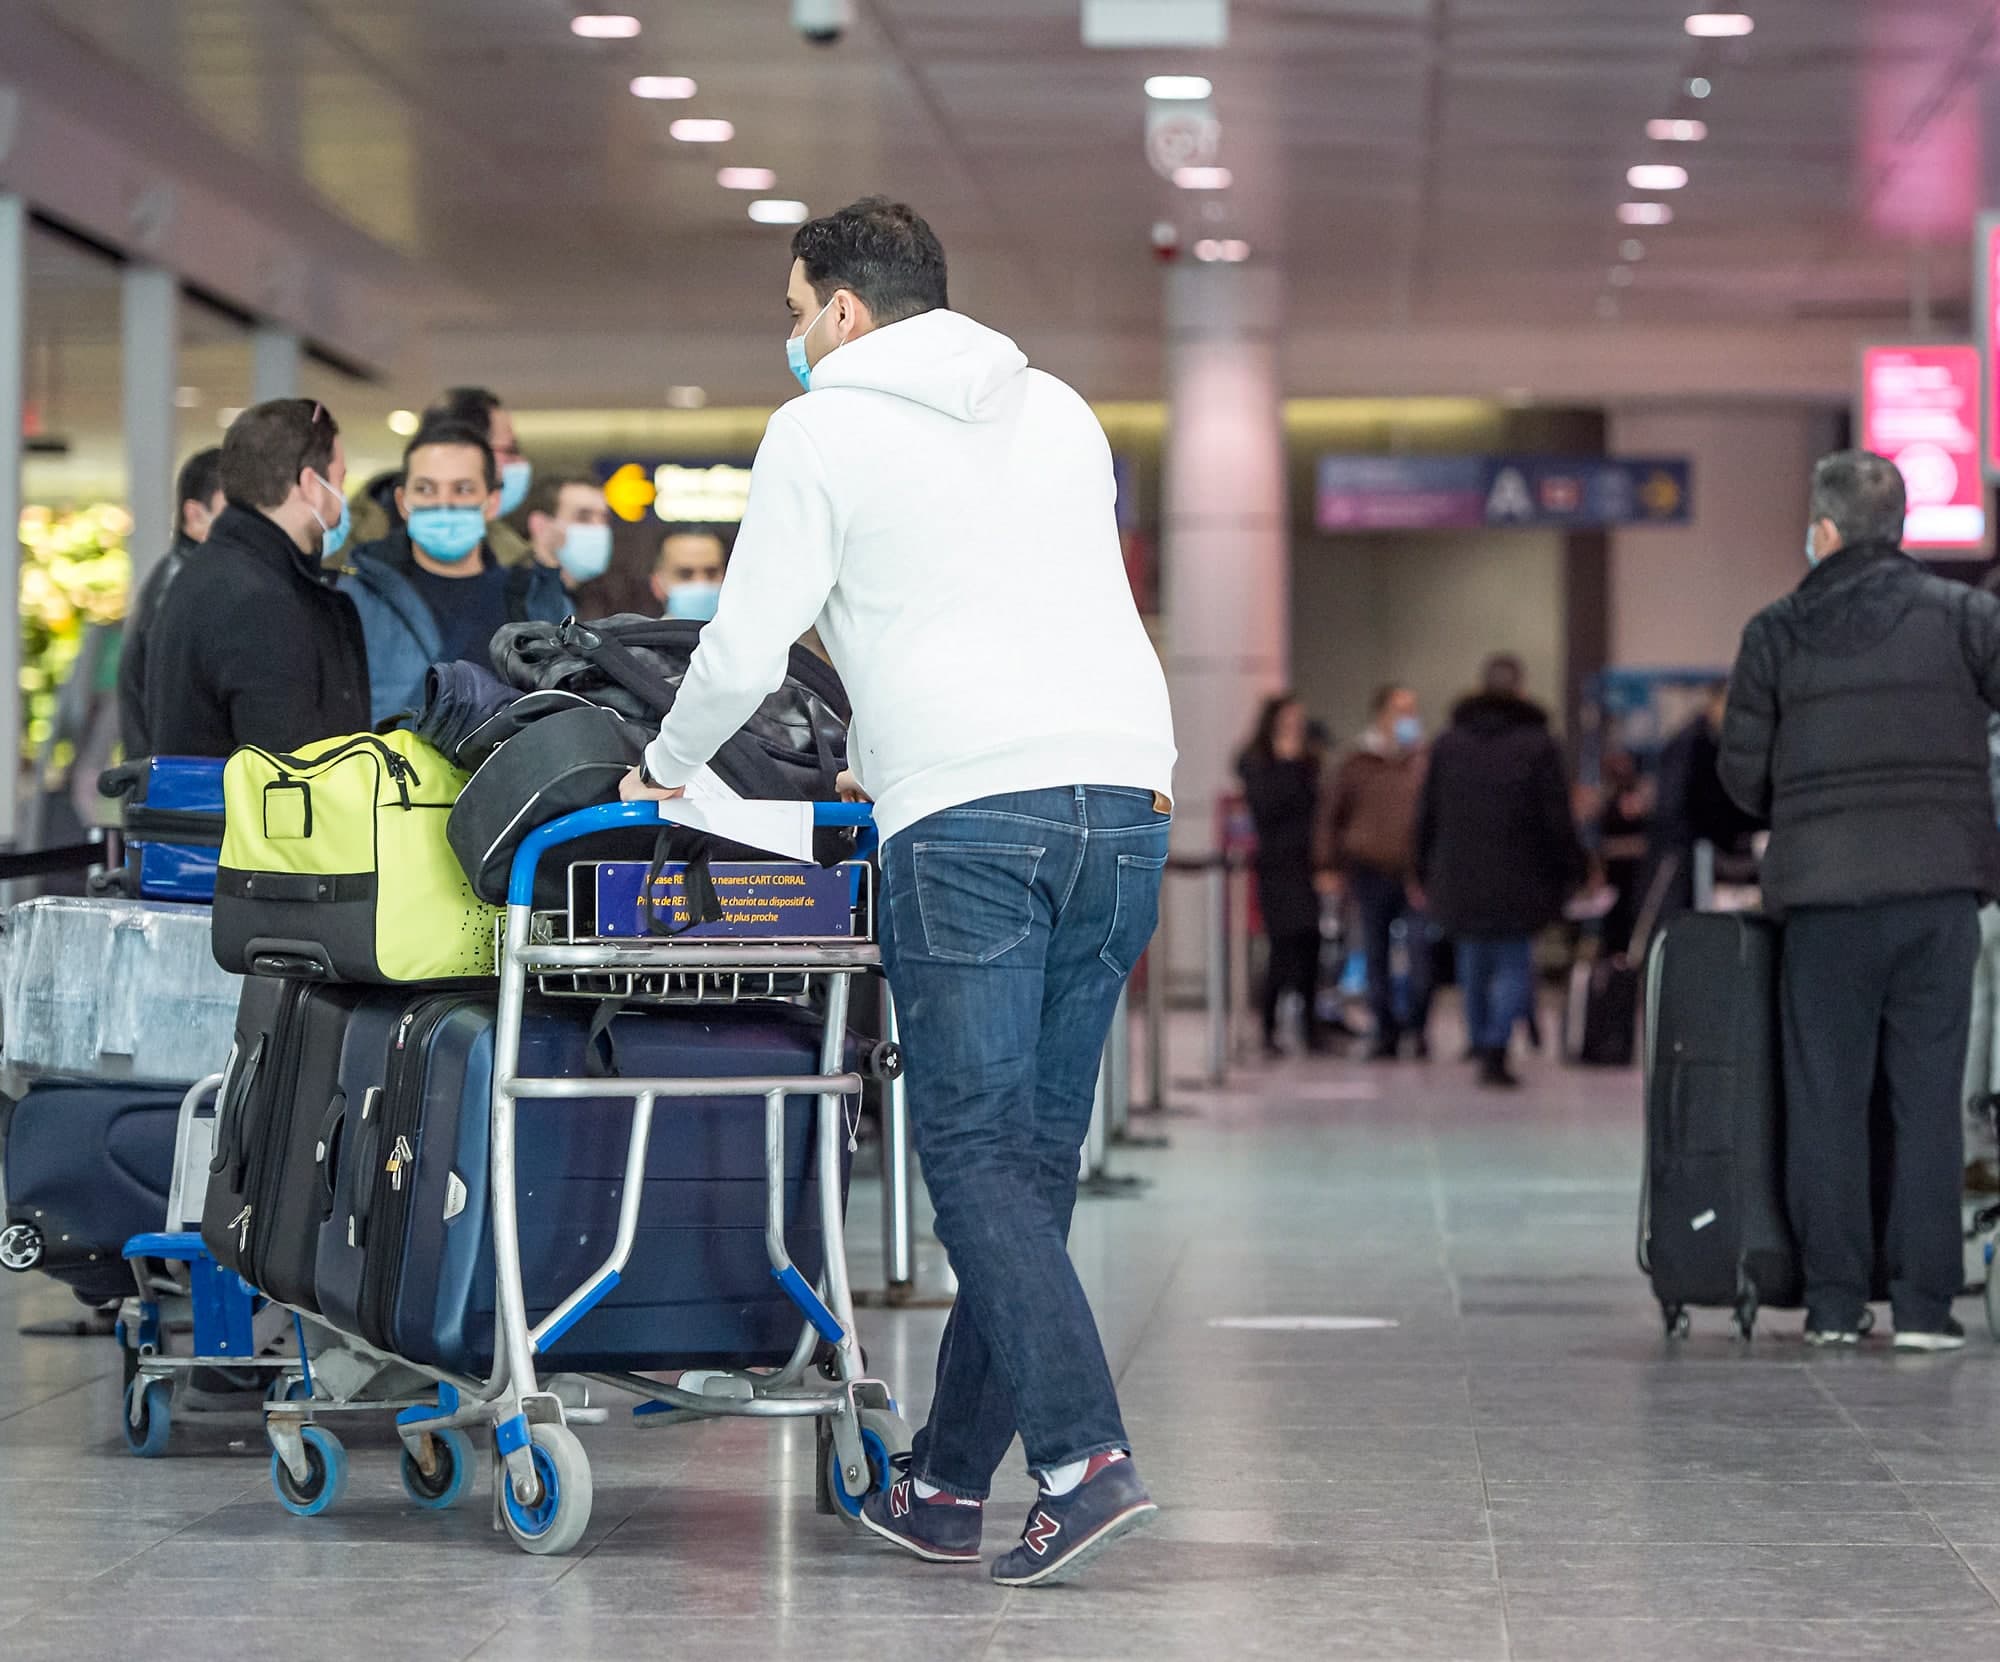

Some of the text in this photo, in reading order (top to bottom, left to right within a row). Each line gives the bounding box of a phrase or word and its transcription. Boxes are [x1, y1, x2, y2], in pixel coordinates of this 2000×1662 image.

[718, 875, 748, 885] nearest
[749, 875, 771, 885] CART
[772, 875, 806, 885] CORRAL
[661, 896, 672, 906] de
[720, 896, 729, 906] le
[729, 896, 757, 906] chariot
[757, 898, 769, 906] au
[769, 896, 805, 908] dispositif
[804, 896, 815, 906] de
[725, 911, 734, 921] le
[734, 911, 750, 923] plus
[750, 911, 779, 923] proche
[890, 1480, 910, 1518] N
[1024, 1511, 1061, 1556] N
